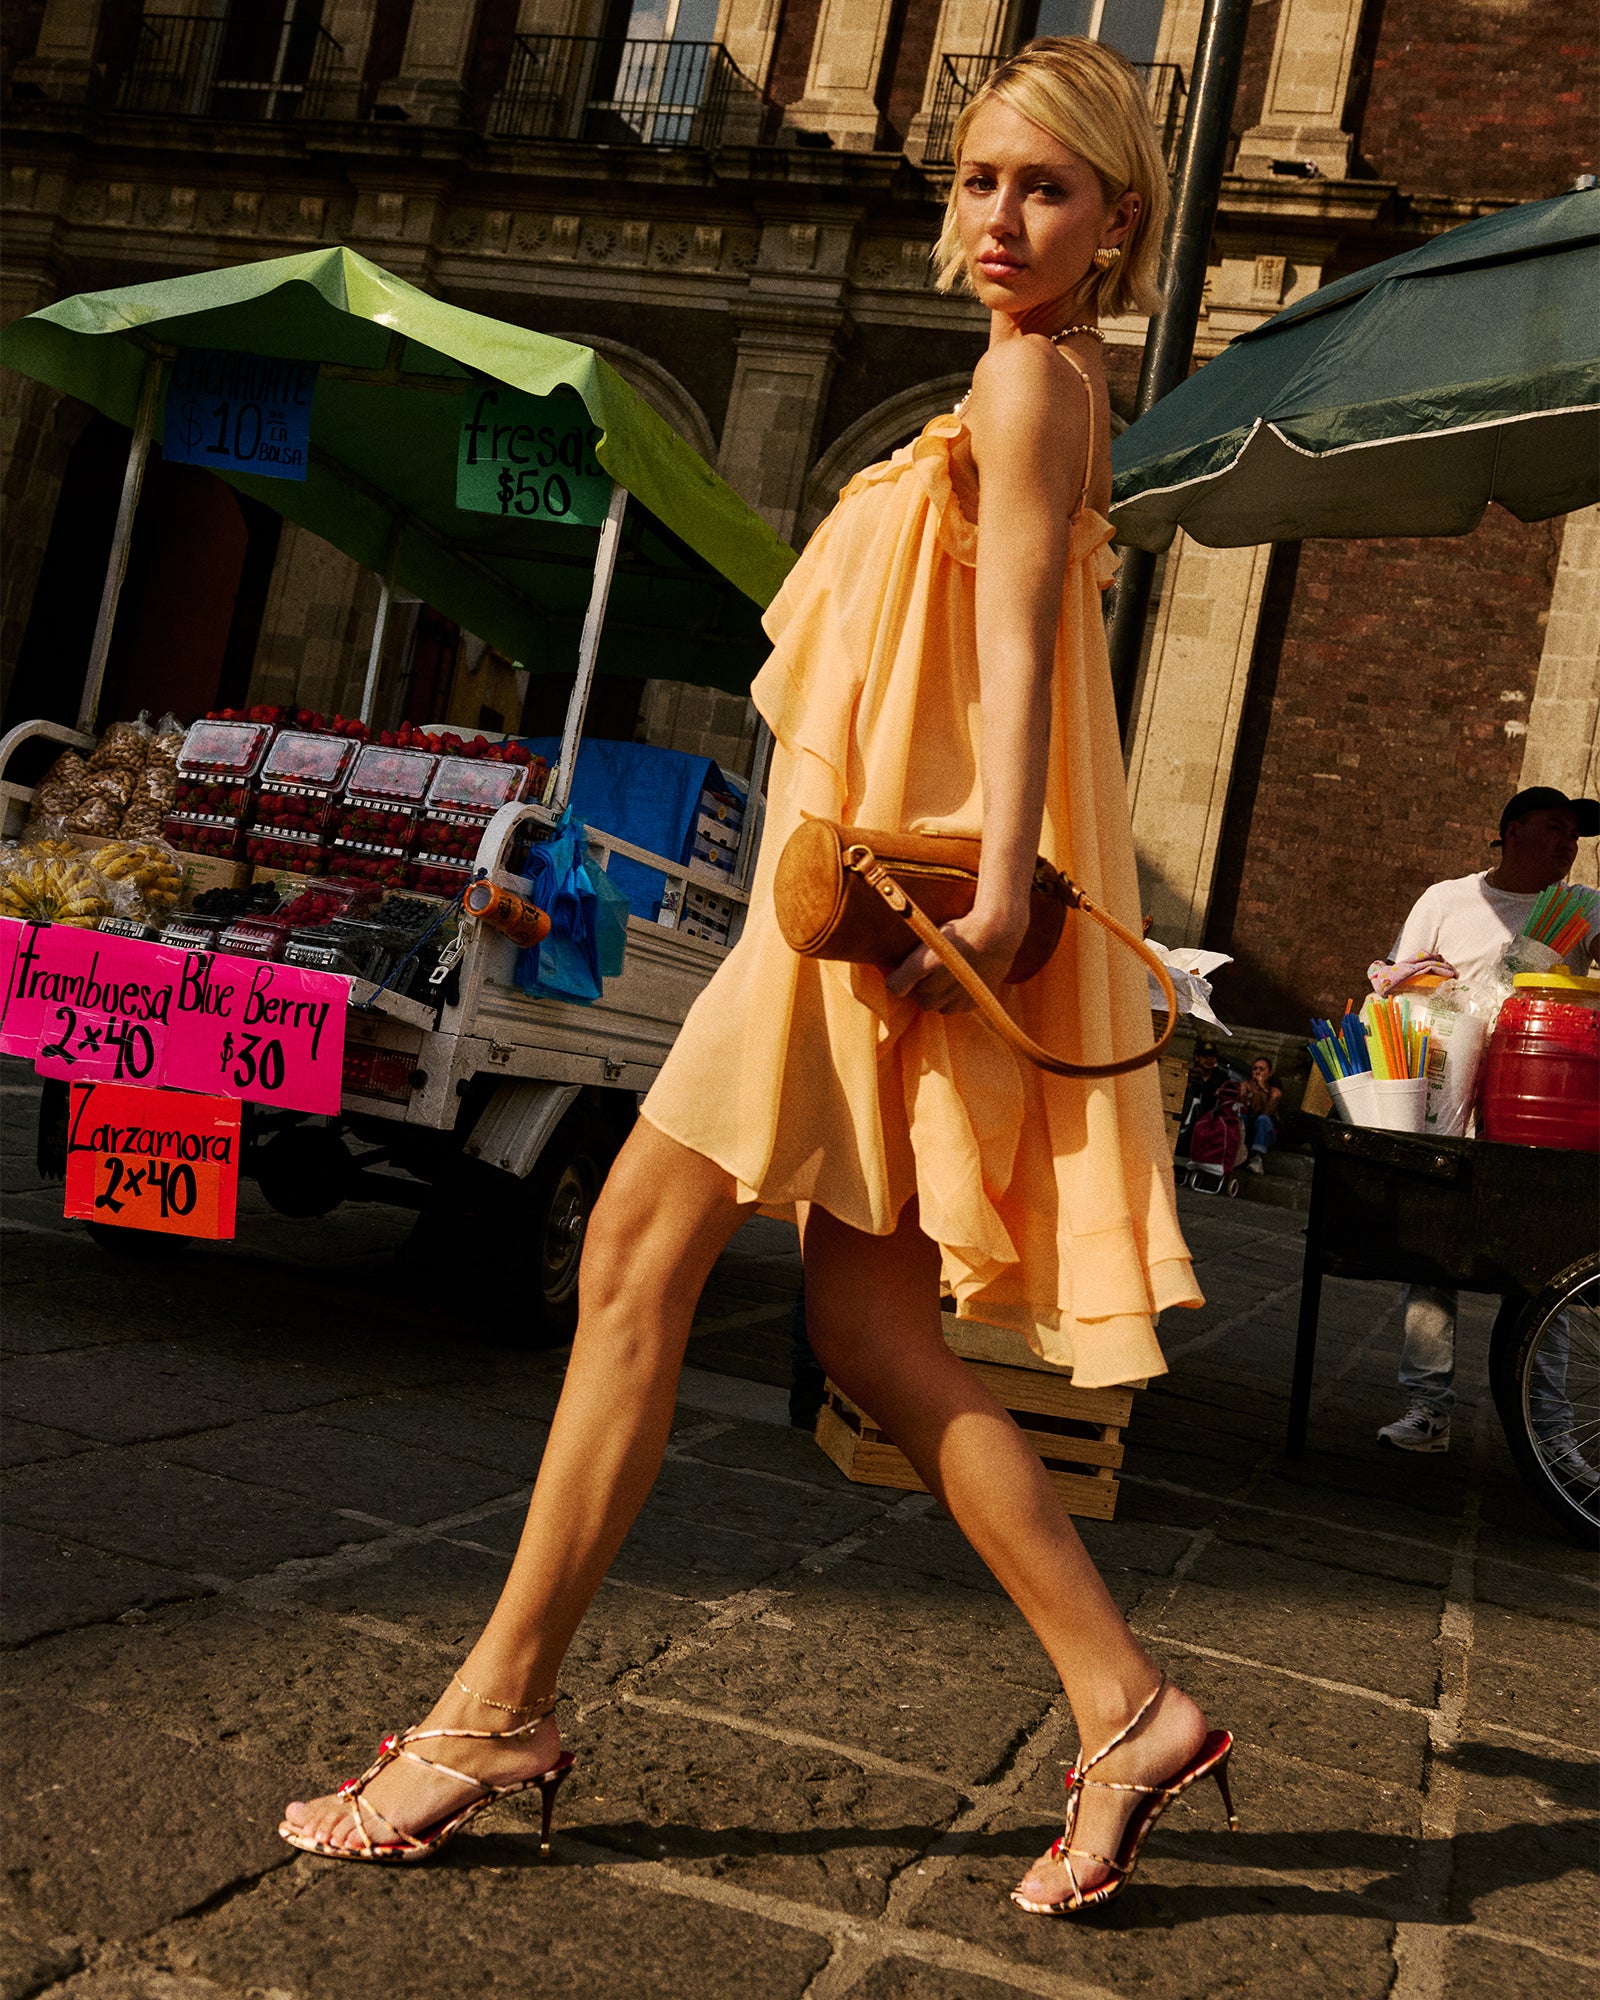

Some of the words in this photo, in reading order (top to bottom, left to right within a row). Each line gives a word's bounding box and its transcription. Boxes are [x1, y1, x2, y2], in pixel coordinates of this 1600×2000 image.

[172, 351, 313, 406] CACAHUATE
[270, 428, 288, 442] LA
[464, 390, 605, 478] fresas
[496, 466, 572, 517] $50
[15, 919, 173, 1026] Frambuesa
[177, 951, 235, 1018] Blue
[243, 965, 330, 1061] Berry
[219, 1031, 285, 1091] $30
[67, 1082, 233, 1165] Zarzamora
